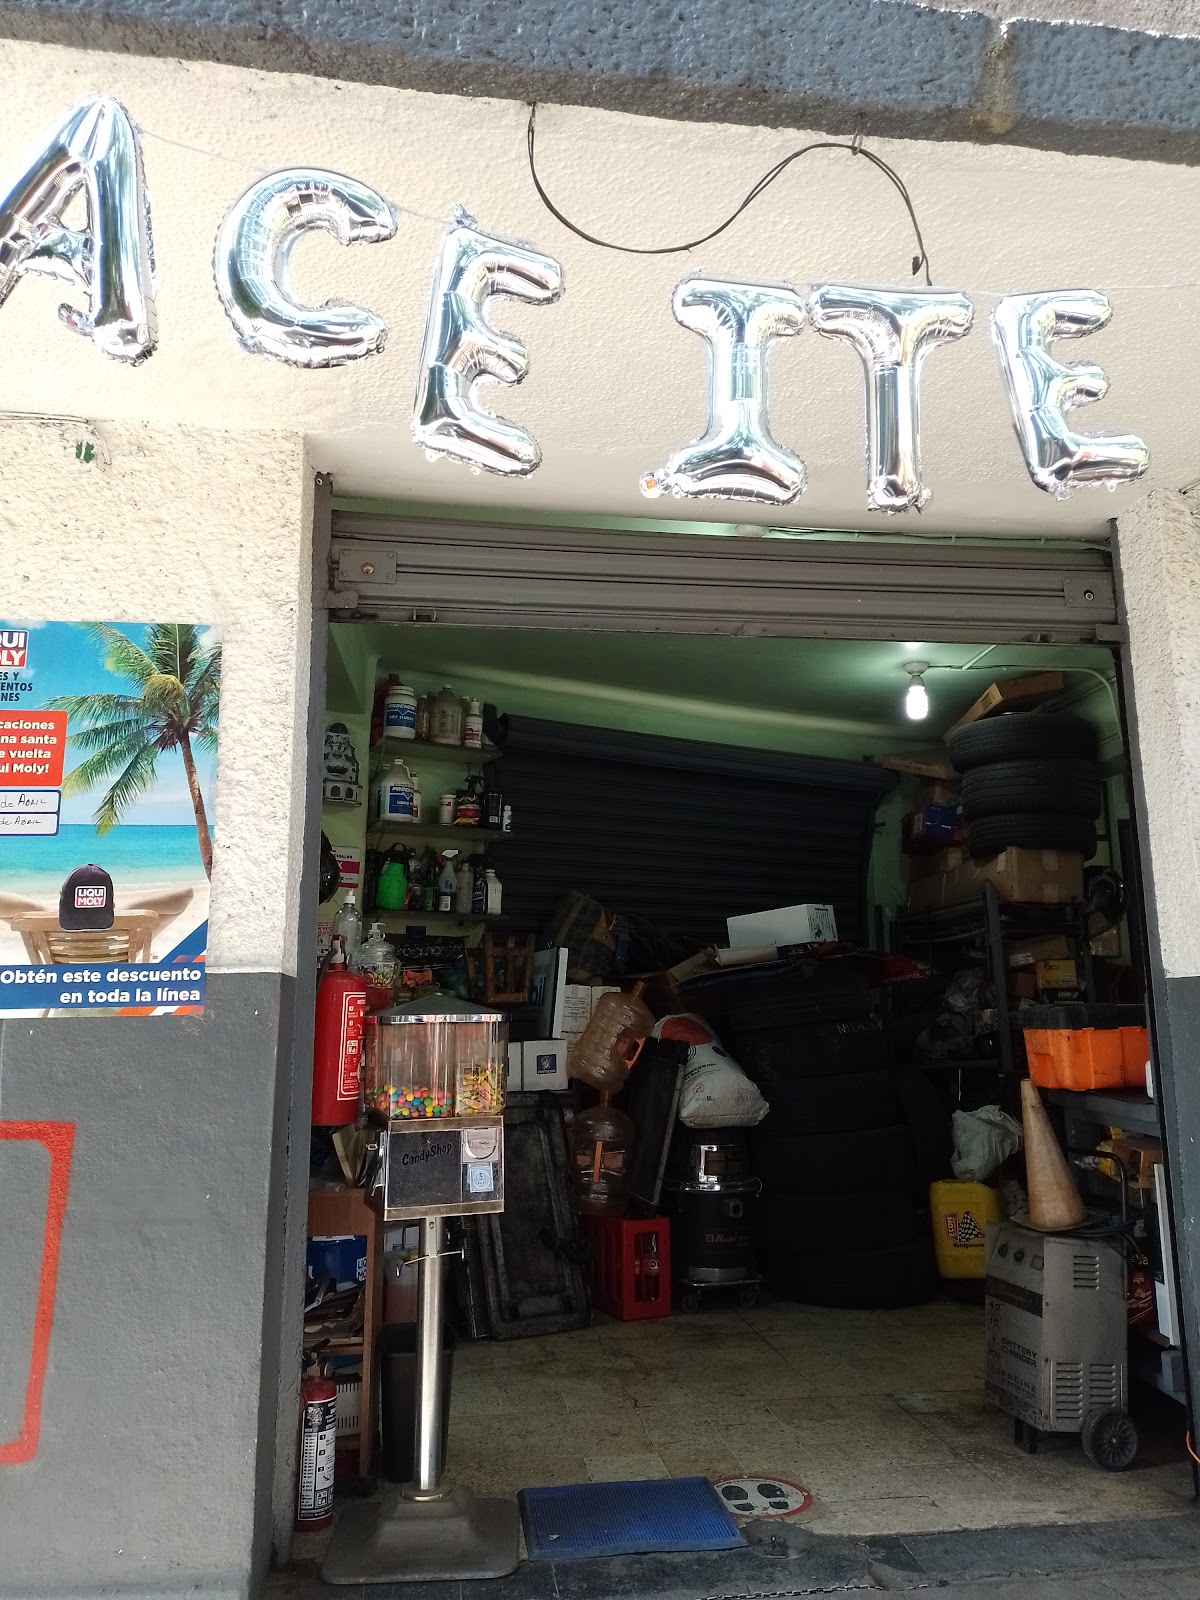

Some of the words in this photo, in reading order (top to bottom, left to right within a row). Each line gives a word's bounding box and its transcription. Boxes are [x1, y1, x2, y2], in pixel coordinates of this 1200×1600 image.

[0, 632, 25, 648] UI
[0, 649, 26, 665] LY
[13, 672, 19, 680] Y
[1, 682, 33, 691] ENTOS
[1, 692, 20, 701] NES
[0, 735, 17, 744] na
[20, 735, 57, 744] santa
[9, 749, 51, 758] vuelta
[12, 763, 49, 775] Moly!
[78, 888, 104, 897] LIQUI
[77, 897, 104, 906] MOLY
[0, 968, 57, 984] Obtén
[62, 970, 101, 983] este
[106, 968, 201, 983] descuento
[60, 992, 82, 1004] en
[88, 989, 130, 1003] toda
[136, 988, 151, 1002] la
[156, 987, 200, 1002] línea
